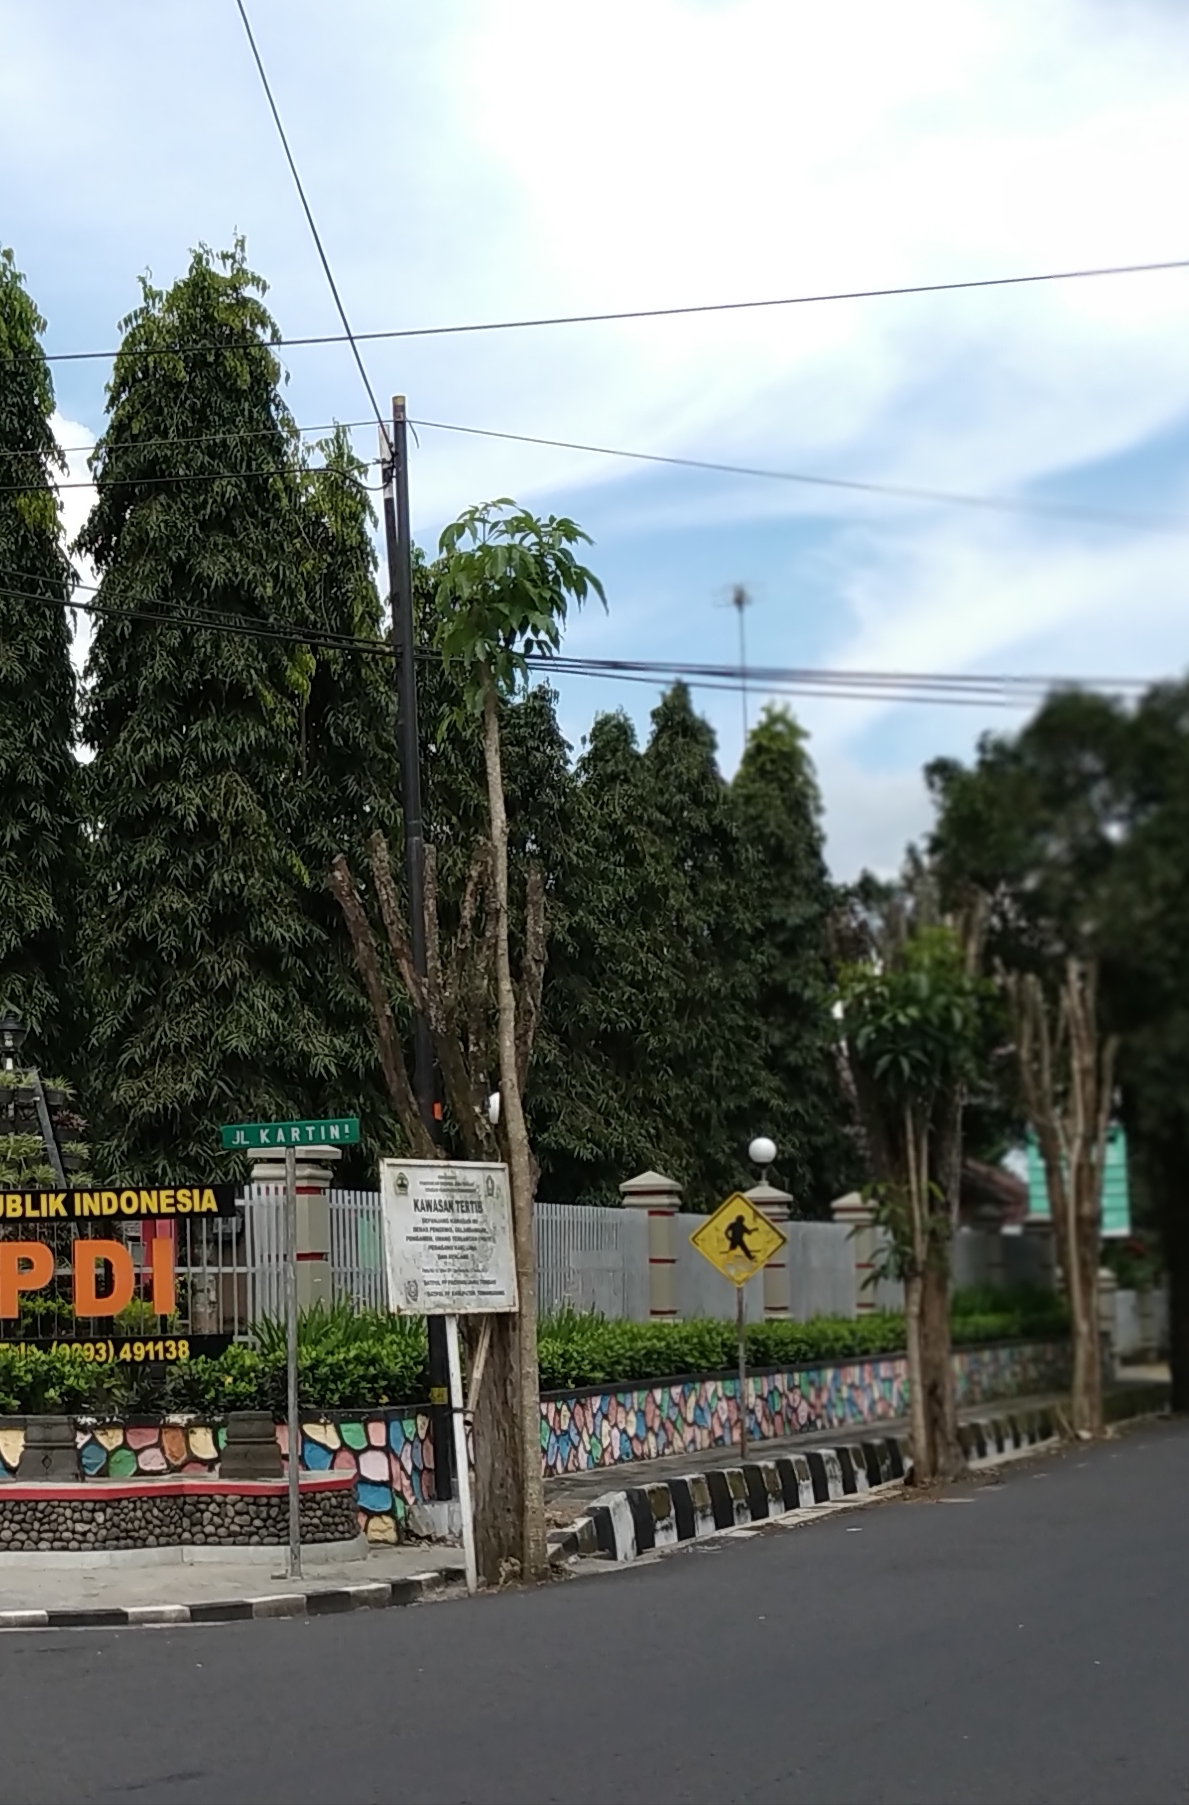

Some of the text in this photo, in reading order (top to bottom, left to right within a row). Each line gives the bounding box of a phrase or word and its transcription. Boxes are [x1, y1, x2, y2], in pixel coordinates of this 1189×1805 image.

[74, 1188, 219, 1216] INDONESIA
[413, 1198, 484, 1214] KAWASAN TERTIB
[119, 1340, 191, 1362] 491138
